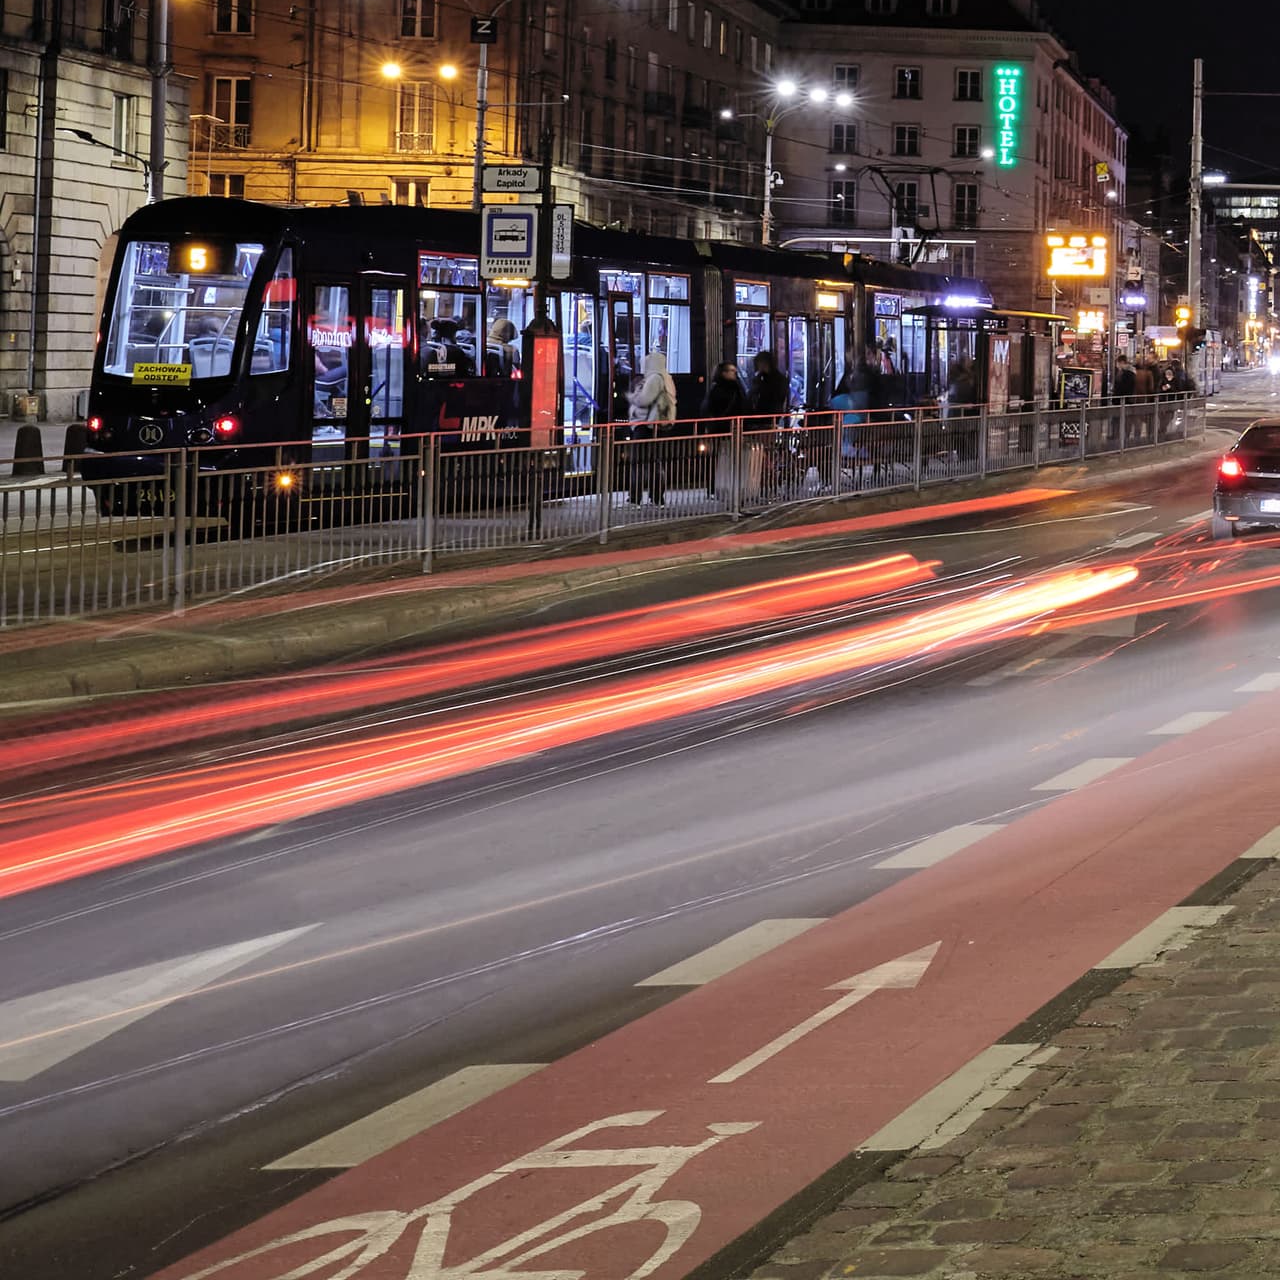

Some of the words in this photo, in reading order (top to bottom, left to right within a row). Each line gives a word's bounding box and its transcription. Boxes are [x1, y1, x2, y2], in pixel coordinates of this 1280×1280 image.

[998, 78, 1017, 166] HOTEL
[497, 168, 528, 178] Arkady
[496, 180, 526, 189] Capitol
[189, 248, 207, 269] 5
[138, 366, 188, 374] ZACHOWAJ
[460, 415, 499, 443] MPK
